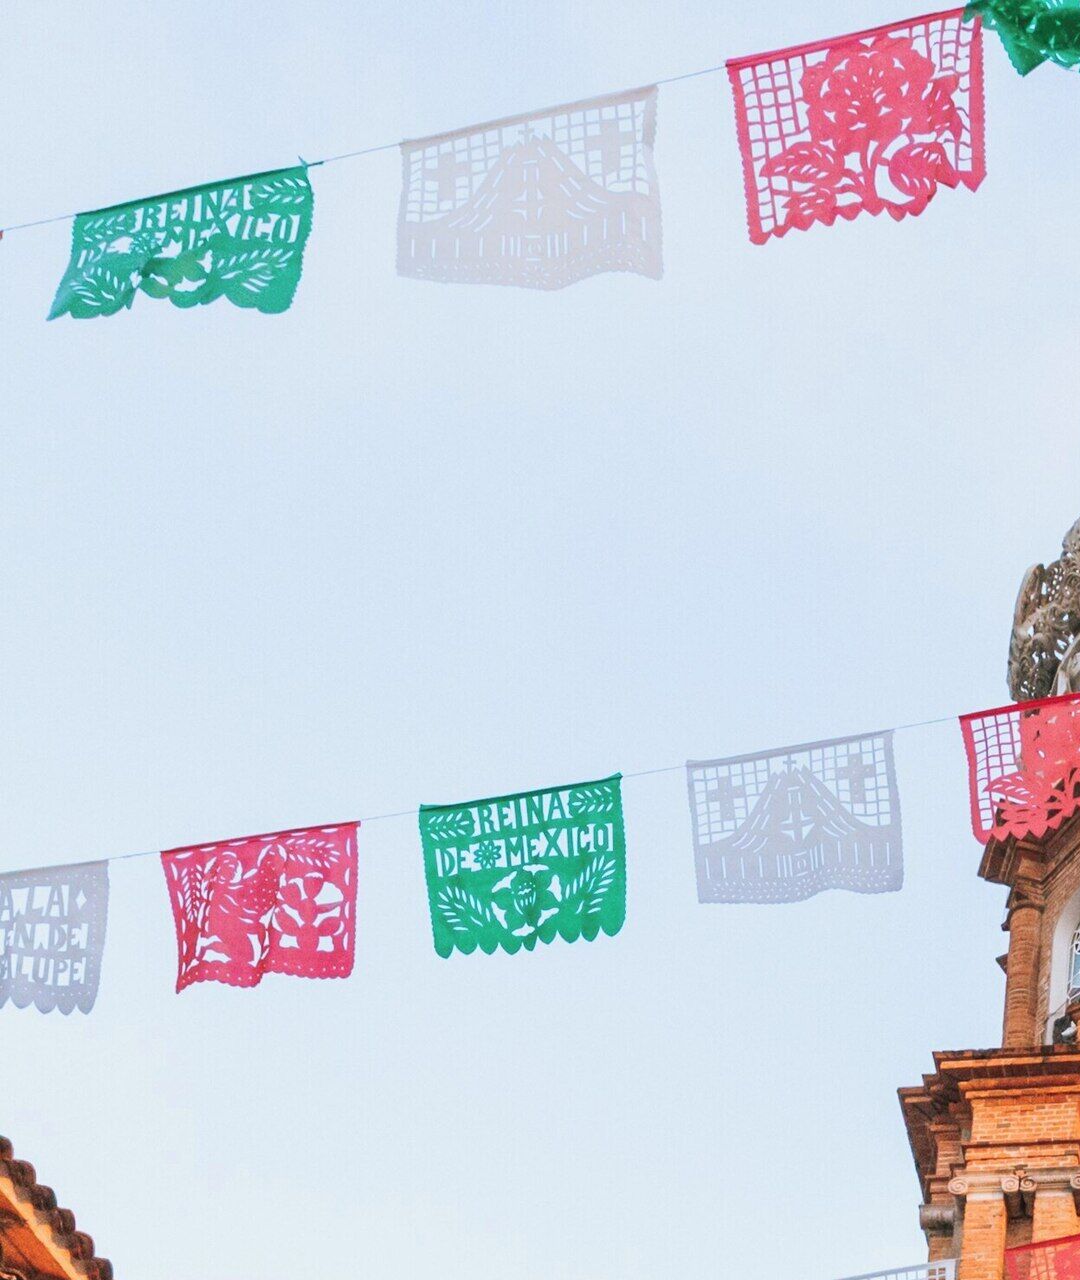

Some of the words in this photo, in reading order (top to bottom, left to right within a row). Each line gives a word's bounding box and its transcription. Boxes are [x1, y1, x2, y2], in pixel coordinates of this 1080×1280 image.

[137, 186, 253, 230] REINA
[474, 790, 573, 836] REINA
[434, 841, 473, 878] DE
[507, 823, 617, 871] MEXICO
[34, 884, 72, 918] LA
[54, 922, 88, 952] DE
